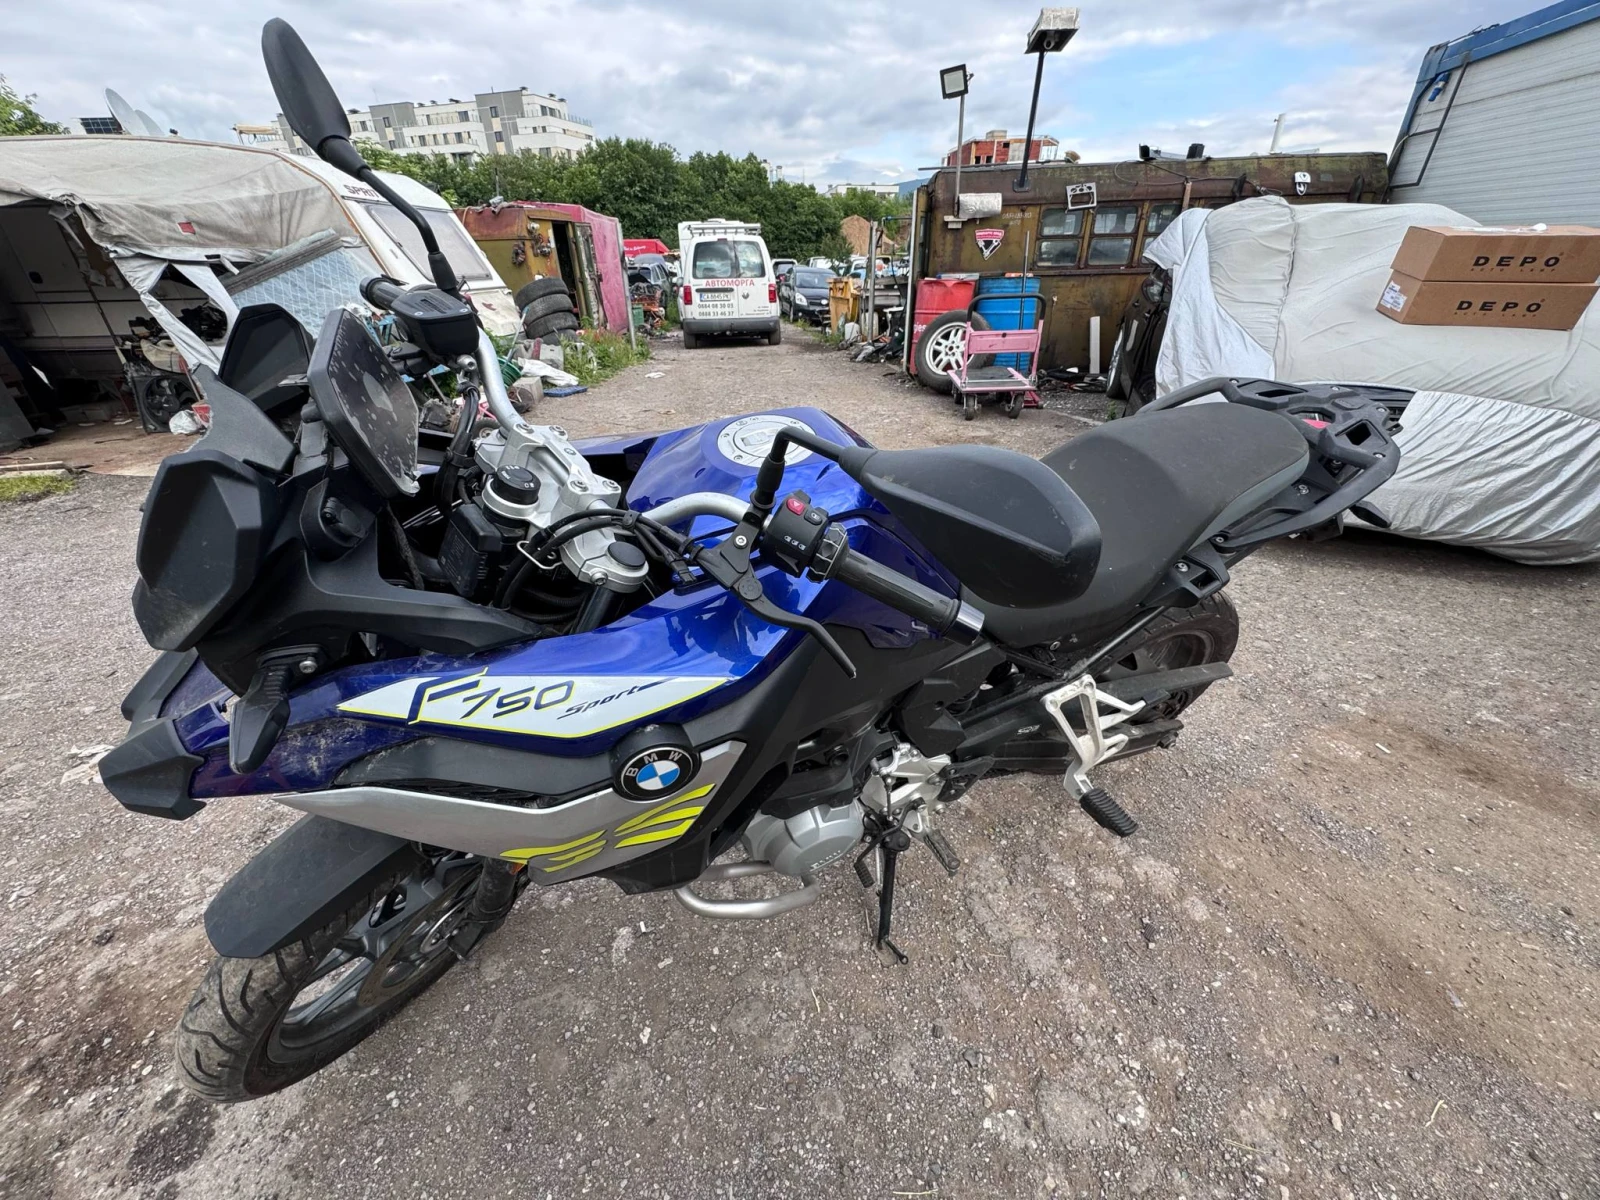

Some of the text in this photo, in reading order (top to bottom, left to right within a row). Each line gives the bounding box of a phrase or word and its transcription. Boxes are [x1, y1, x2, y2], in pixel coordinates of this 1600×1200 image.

[343, 184, 380, 198] SPRIT
[1473, 256, 1560, 267] DEPO
[705, 279, 755, 287] АВТОМОРГА
[1456, 301, 1542, 313] DEPO
[557, 685, 643, 720] Sport
[625, 750, 683, 777] BMW
